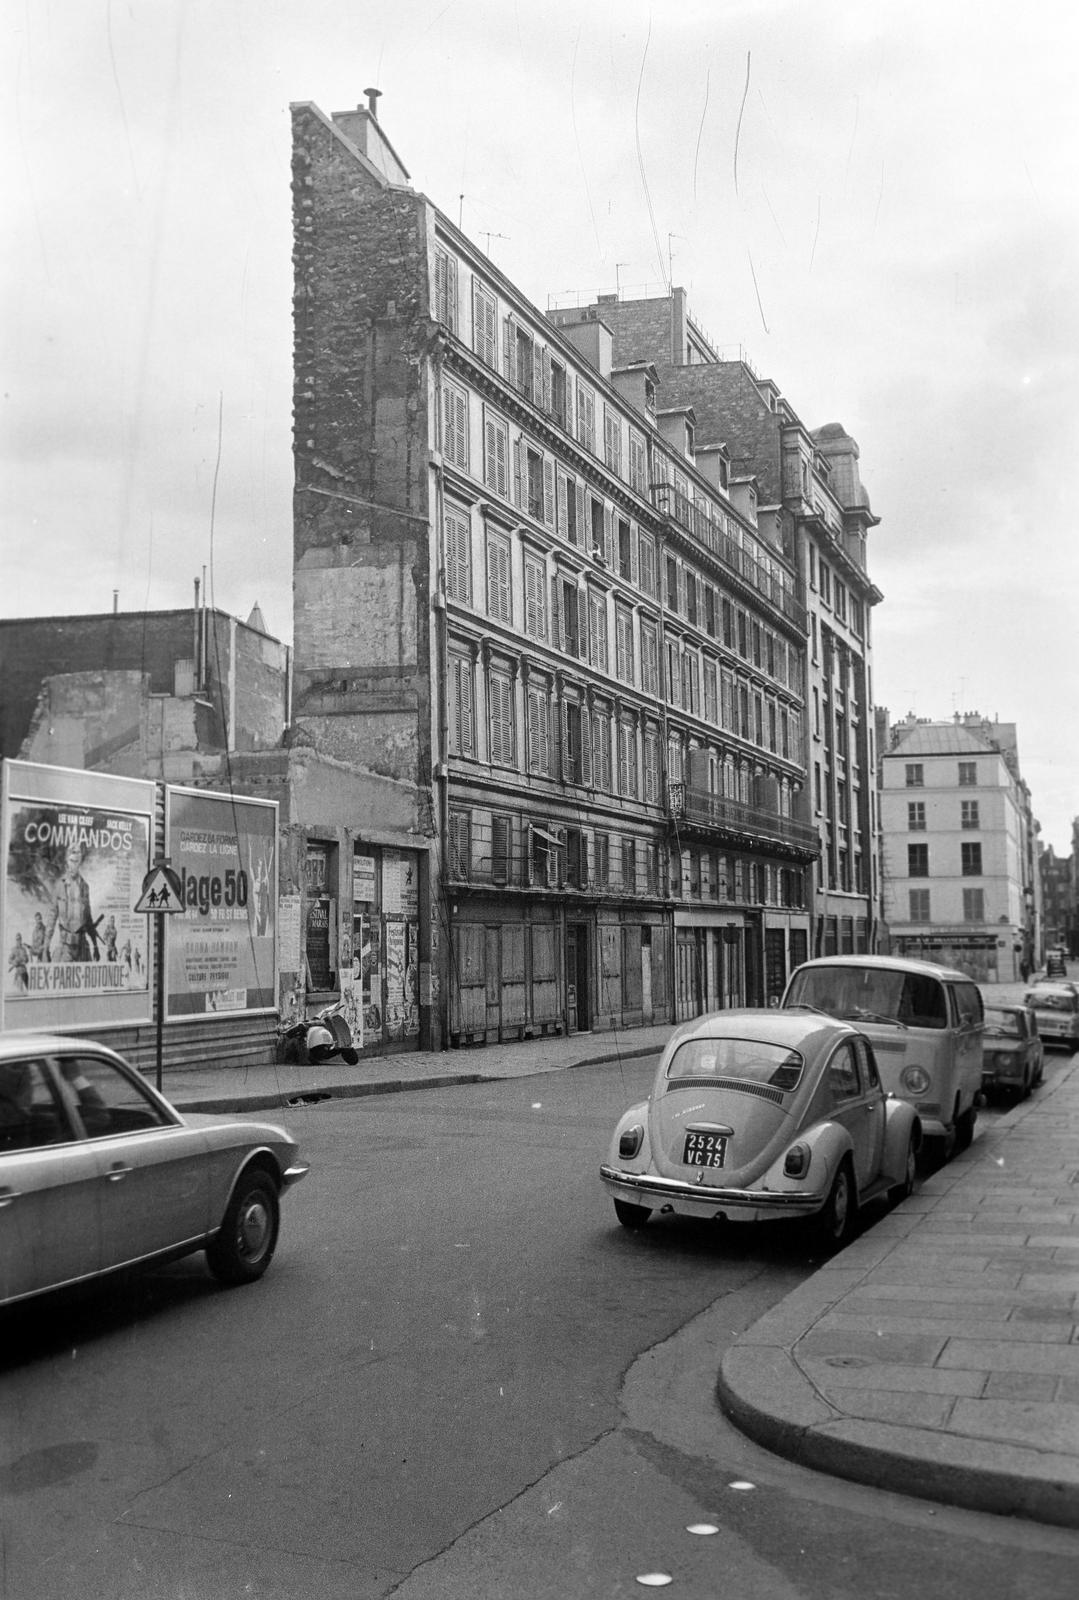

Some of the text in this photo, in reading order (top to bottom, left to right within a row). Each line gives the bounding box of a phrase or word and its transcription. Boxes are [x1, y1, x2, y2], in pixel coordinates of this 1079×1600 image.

[24, 822, 133, 851] COMMANDOS
[180, 831, 207, 843] GARDEZ
[215, 834, 239, 845] FORME
[179, 841, 238, 856] GARDEZ LA LIGNE
[181, 867, 222, 916] lage
[224, 869, 248, 908] 50
[28, 965, 125, 990] REX PARIS ROTONDE
[688, 1135, 722, 1151] 2524
[687, 1150, 721, 1167] VC 75
